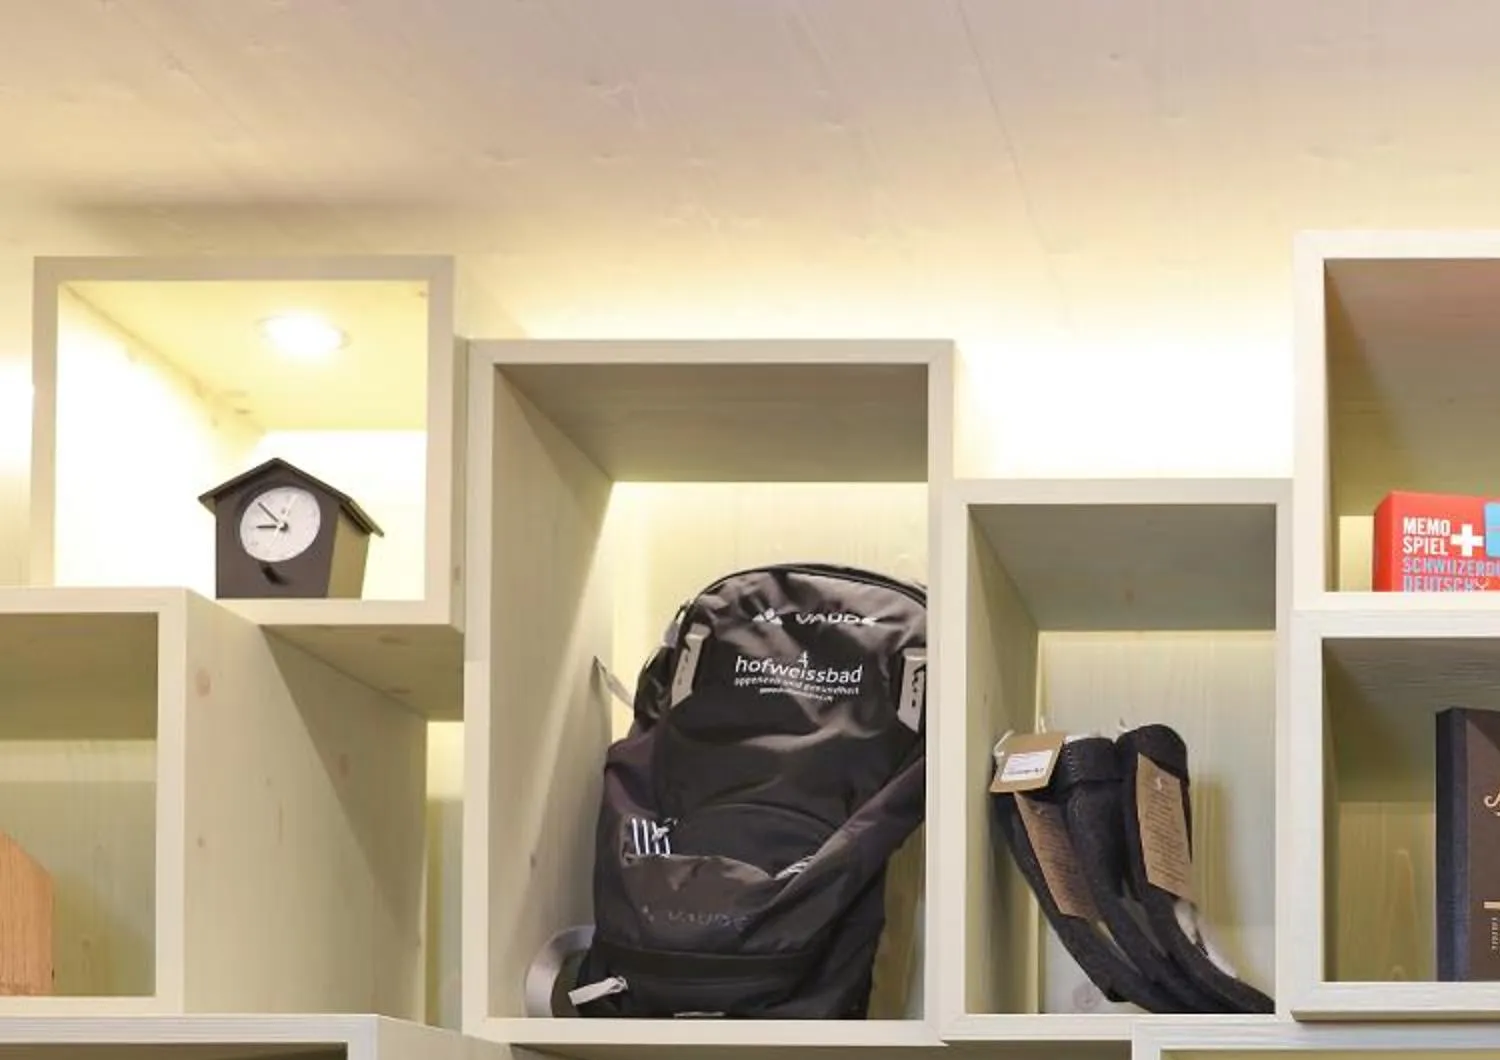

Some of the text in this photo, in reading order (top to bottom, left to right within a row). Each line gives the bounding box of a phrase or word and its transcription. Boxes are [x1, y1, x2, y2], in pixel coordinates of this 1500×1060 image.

[1403, 516, 1451, 536] MEMO
[1403, 536, 1449, 555] SPIEL
[735, 653, 864, 684] hofweissbad
